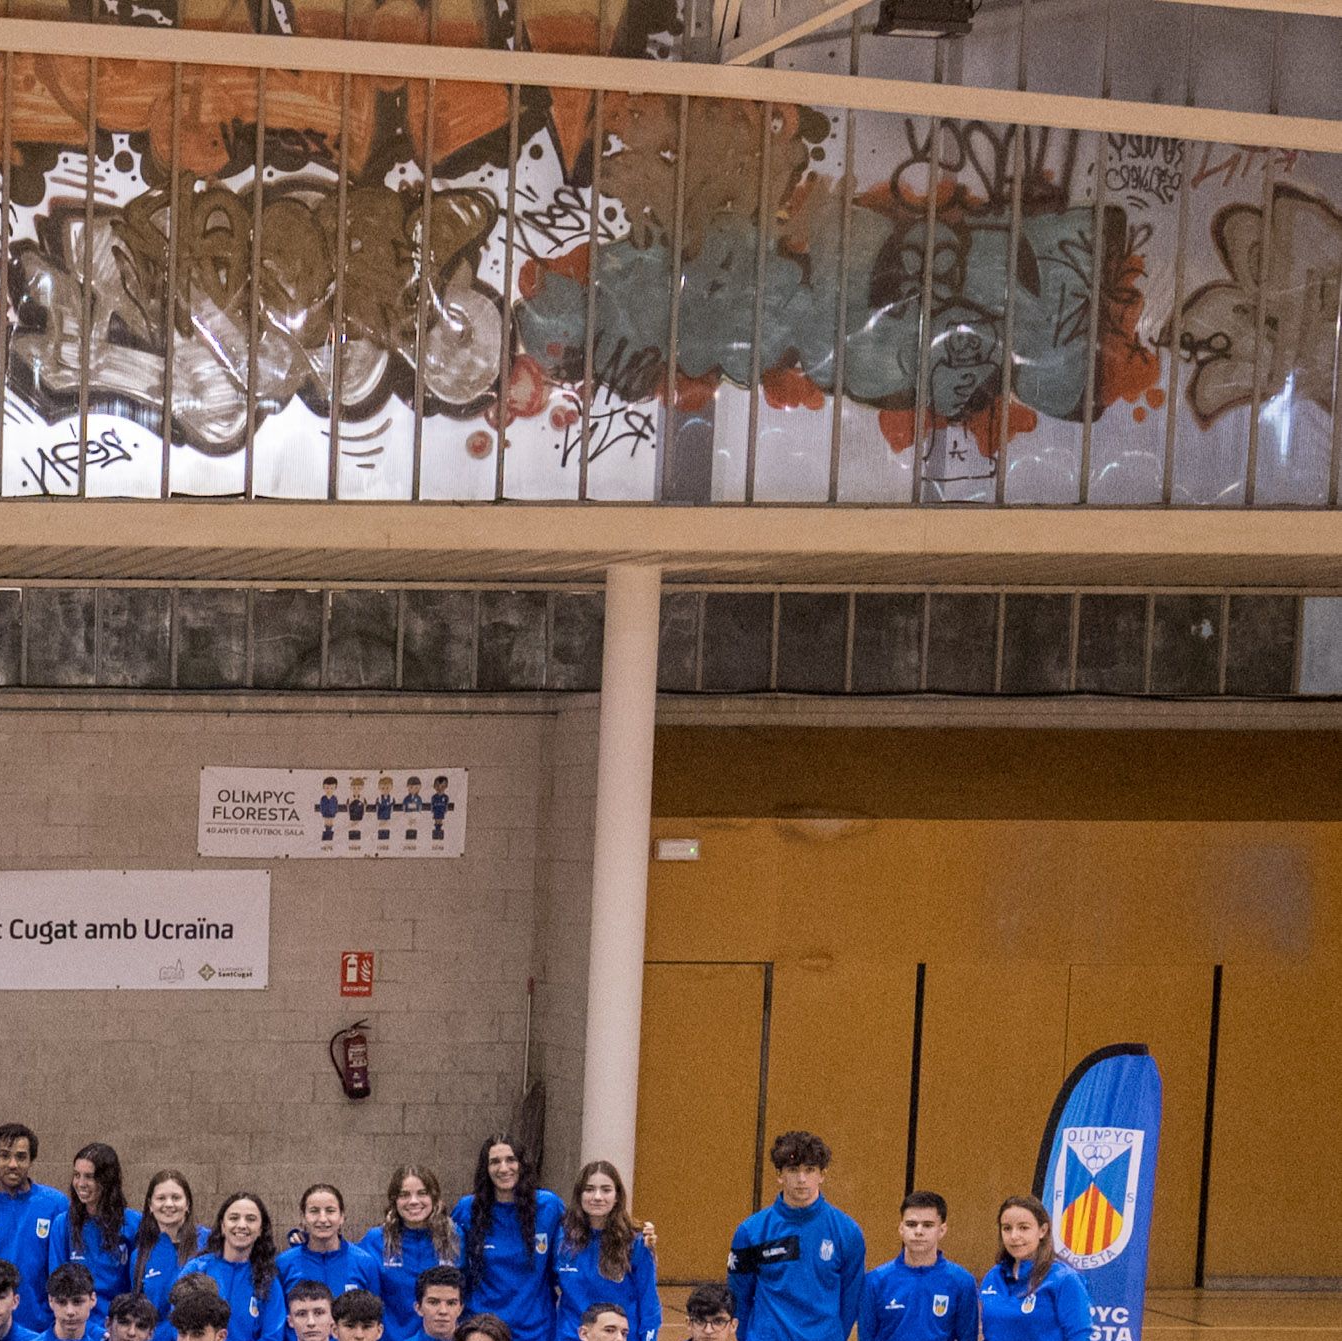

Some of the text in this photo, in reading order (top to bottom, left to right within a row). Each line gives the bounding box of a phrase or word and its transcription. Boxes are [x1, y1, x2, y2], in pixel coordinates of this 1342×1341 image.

[218, 789, 295, 805] OLIMPYC
[212, 806, 301, 822] FLORESTA
[217, 827, 239, 836] ANYS
[240, 828, 251, 836] DE
[252, 828, 283, 836] FUTBOL
[284, 829, 305, 837] SALA
[8, 918, 78, 945] Cugat
[85, 917, 137, 940] amb
[144, 917, 234, 940] Ucraïna
